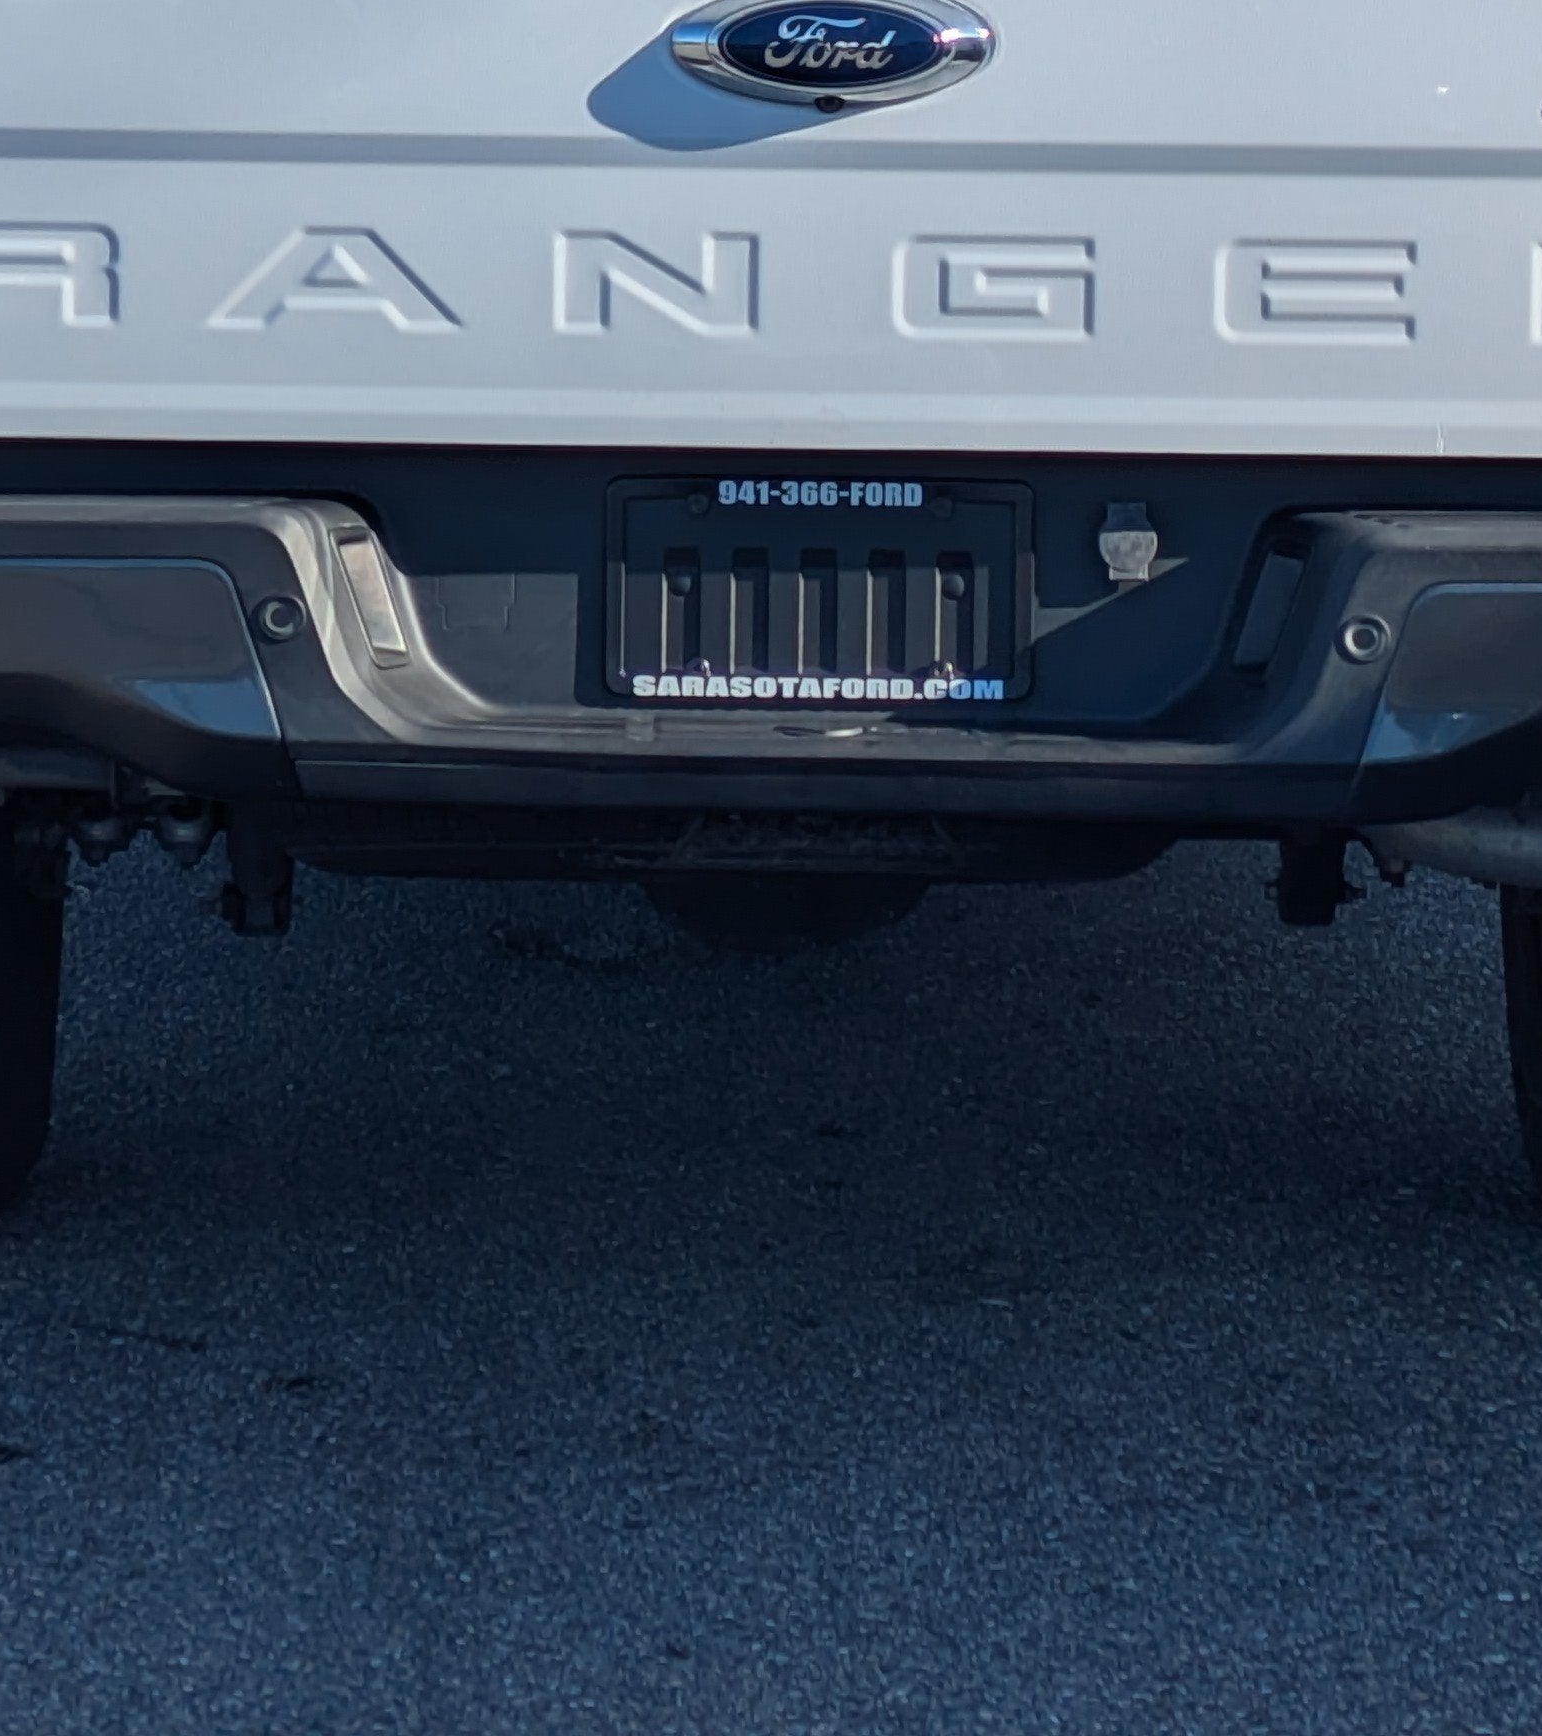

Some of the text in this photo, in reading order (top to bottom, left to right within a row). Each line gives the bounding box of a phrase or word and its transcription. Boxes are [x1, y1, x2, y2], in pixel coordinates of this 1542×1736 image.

[764, 14, 897, 70] Ford
[717, 480, 923, 508] 941-366-FORD
[632, 674, 1005, 701] SARASOTAFORD.COM
